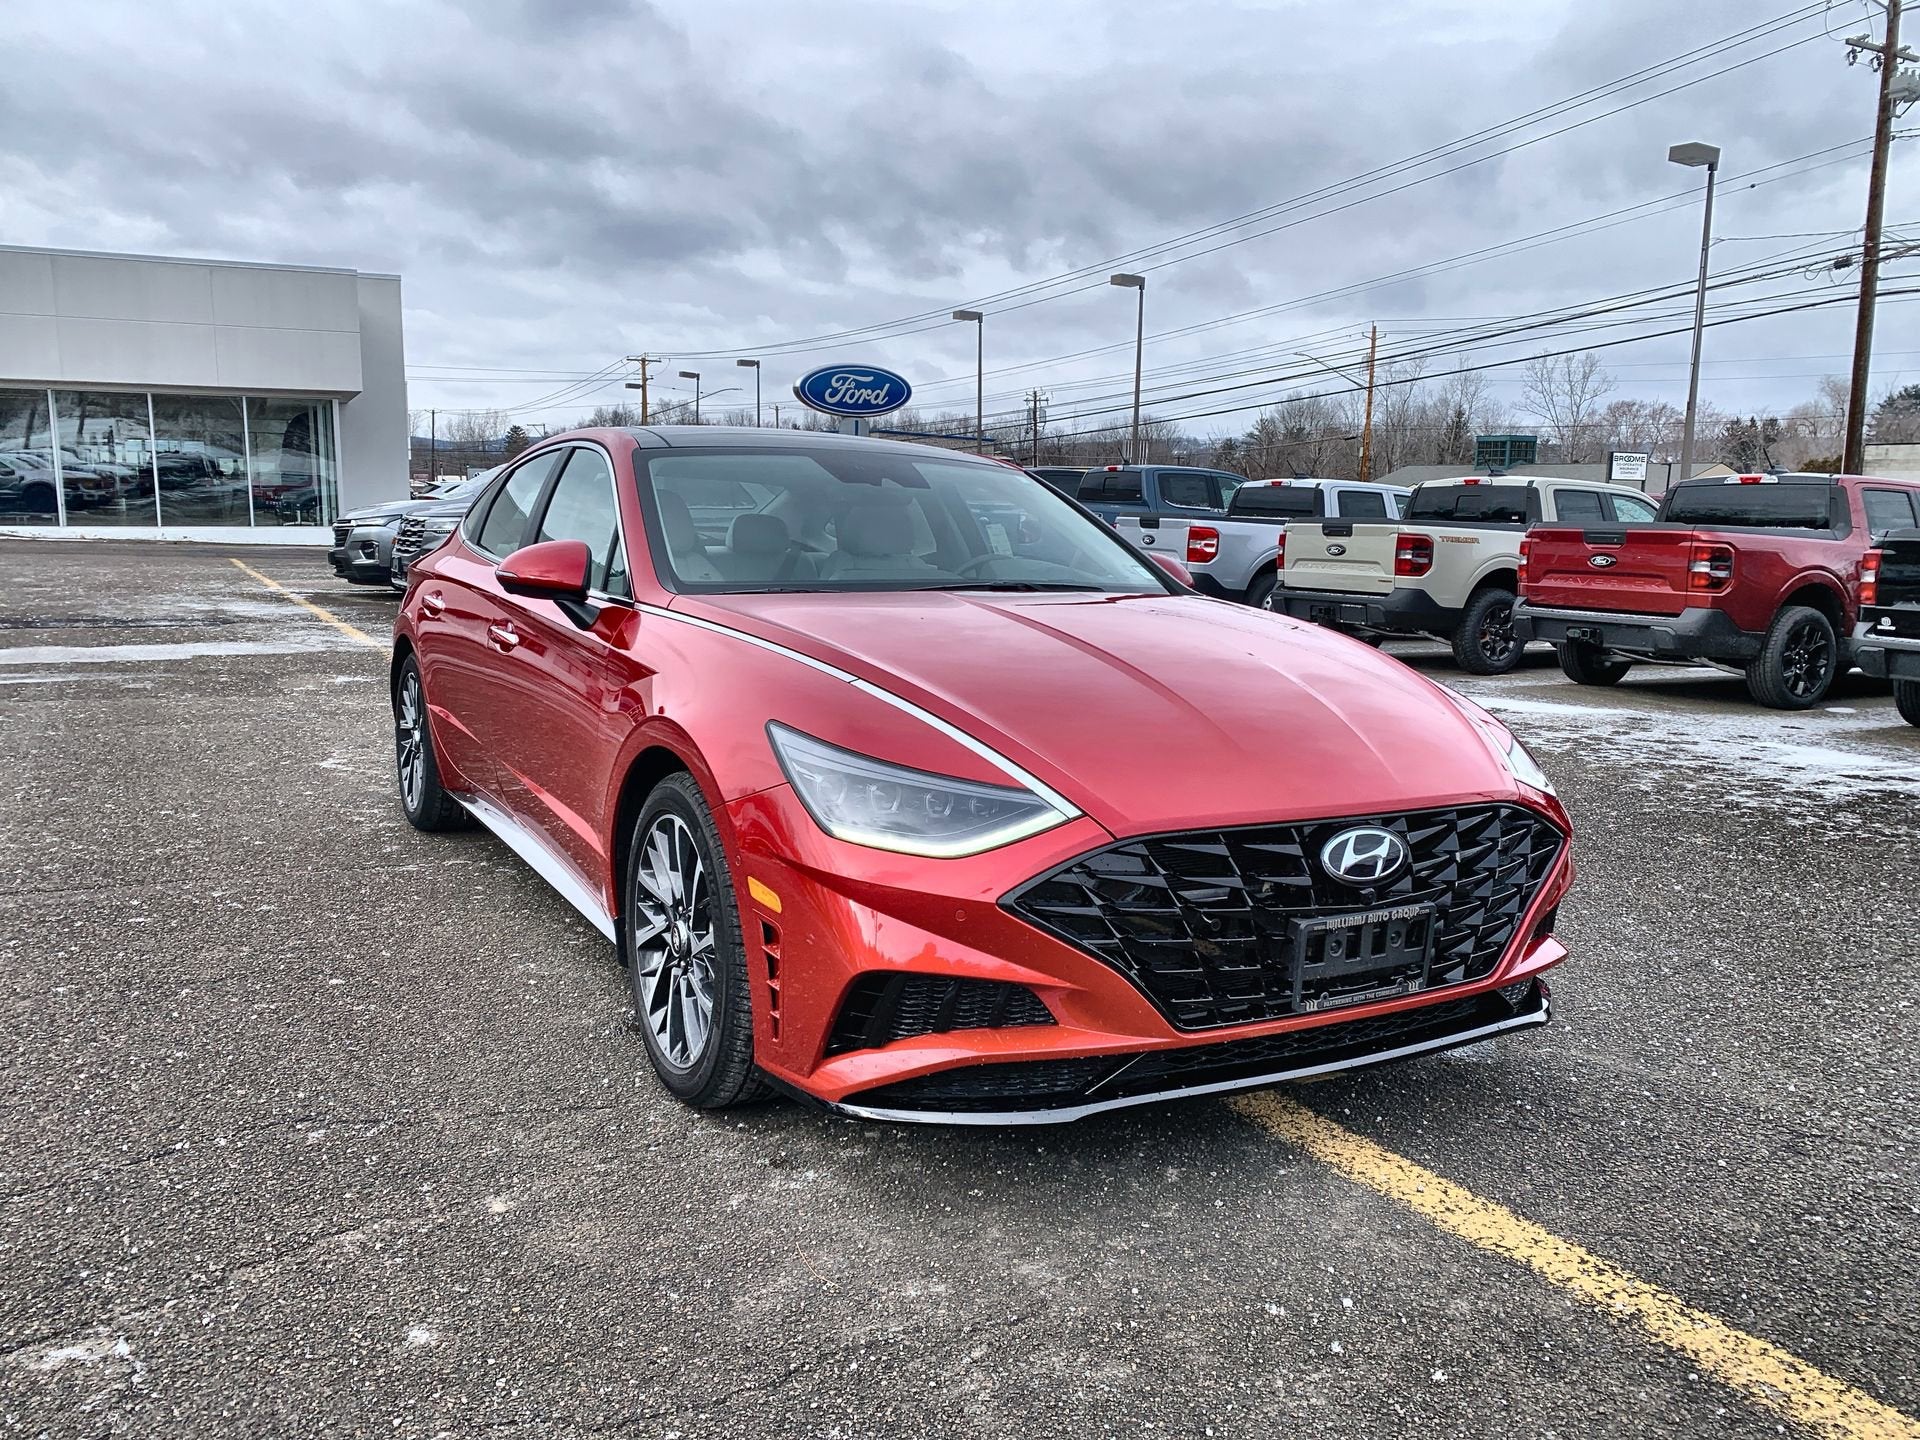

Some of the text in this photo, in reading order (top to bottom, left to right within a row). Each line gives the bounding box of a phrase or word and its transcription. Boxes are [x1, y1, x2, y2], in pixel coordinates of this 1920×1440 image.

[824, 373, 890, 404] Ford
[1614, 455, 1646, 463] BROOME
[1439, 535, 1481, 544] TREMOR
[1367, 911, 1390, 924] AUTO
[1353, 994, 1366, 1002] WITH
[1375, 986, 1403, 998] COMMUNITY
